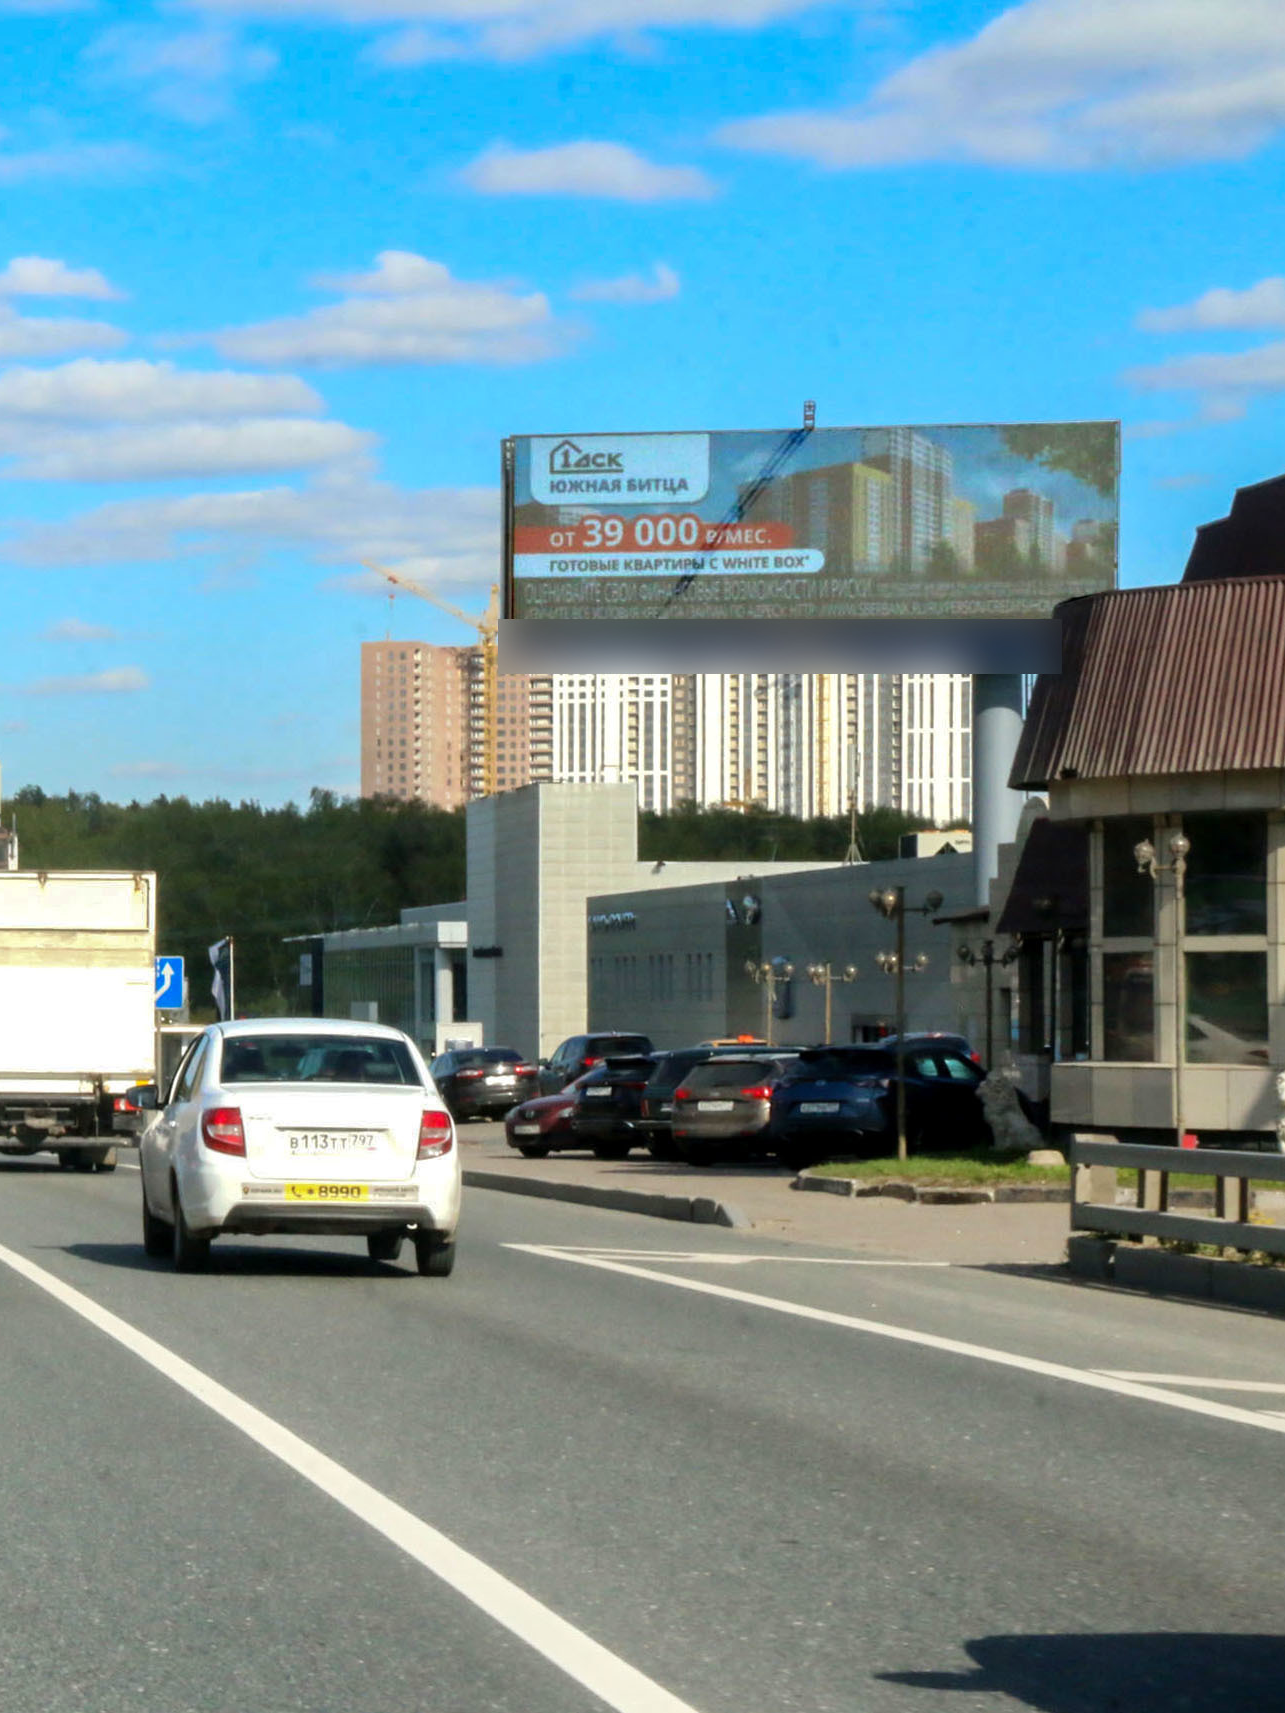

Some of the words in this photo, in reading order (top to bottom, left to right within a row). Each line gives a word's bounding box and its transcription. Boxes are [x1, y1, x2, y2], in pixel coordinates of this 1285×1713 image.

[549, 478, 622, 494] ЮЖНАЯ
[626, 477, 689, 496] БИТЦА
[549, 531, 576, 547] ОТ
[582, 518, 624, 548] 39
[634, 516, 699, 547] 000
[549, 559, 620, 573] ГОТОВЫЕ
[623, 557, 705, 571] КВАРТИРЫ
[709, 557, 719, 570] С
[722, 556, 770, 569] WHITE
